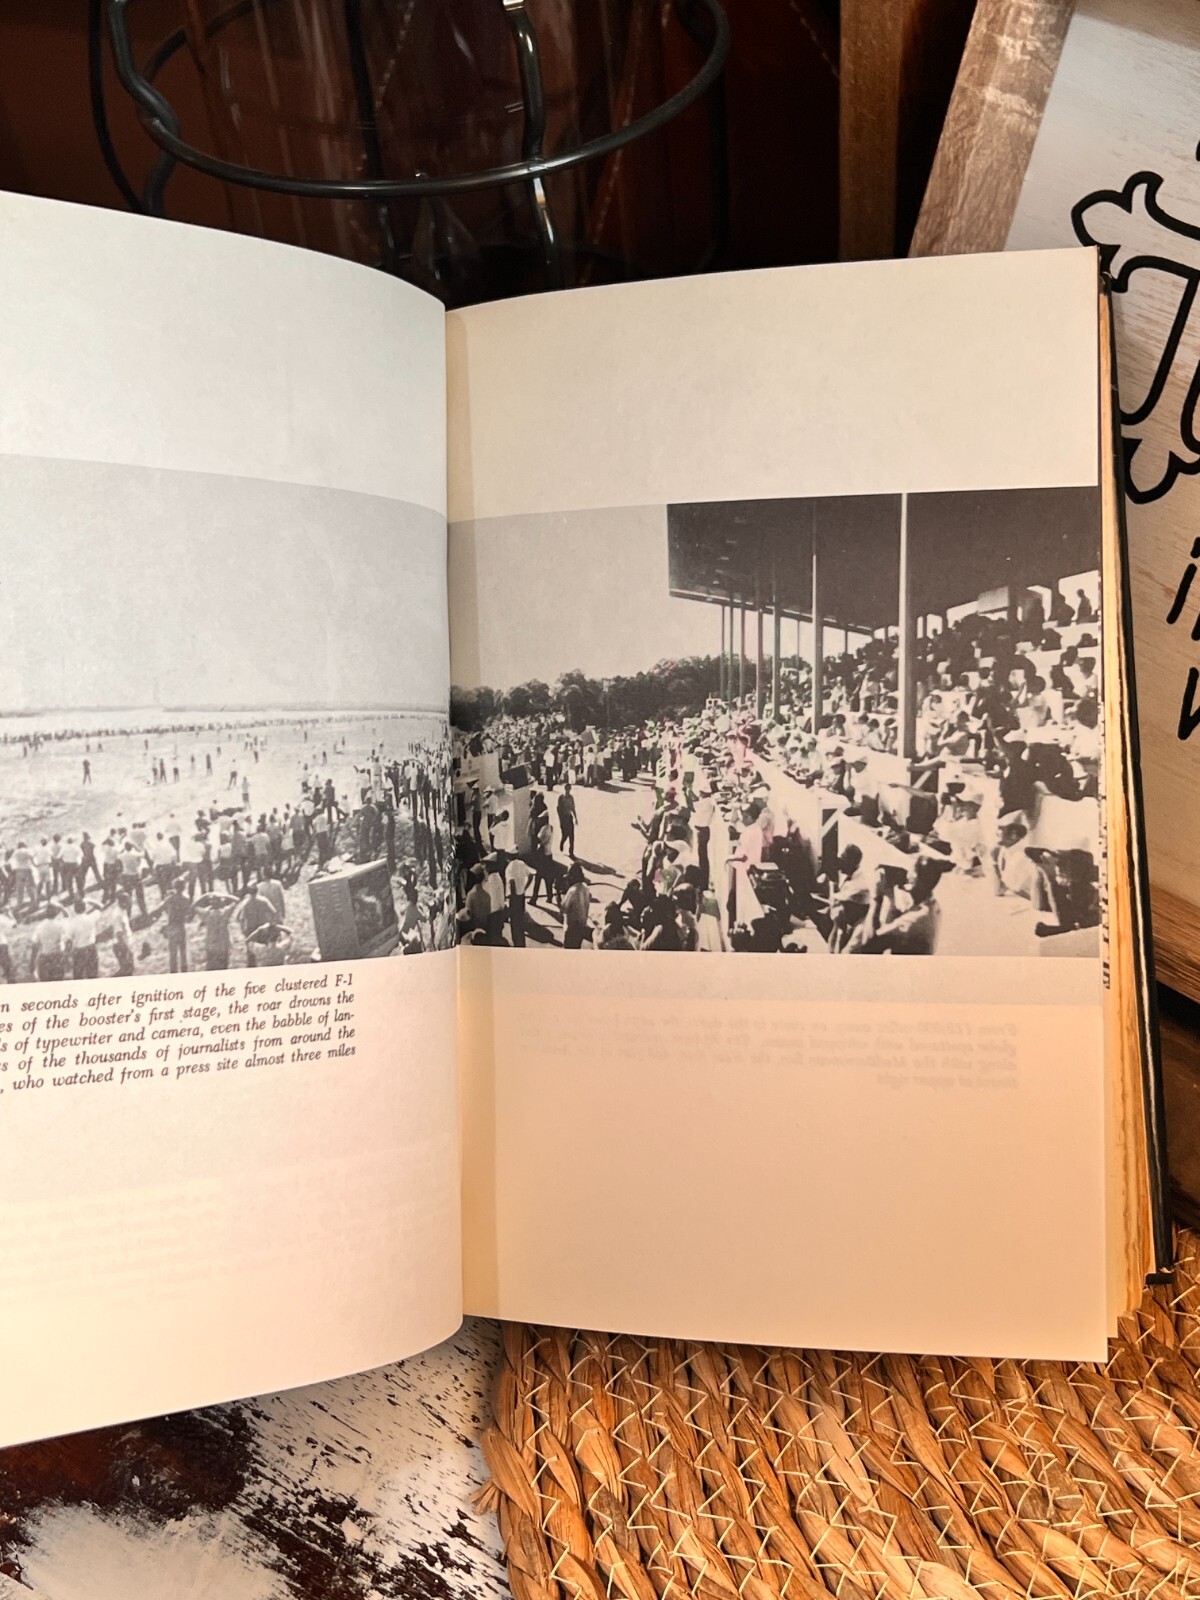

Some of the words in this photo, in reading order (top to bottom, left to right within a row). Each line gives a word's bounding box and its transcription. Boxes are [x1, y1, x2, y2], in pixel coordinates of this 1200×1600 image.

[21, 995, 79, 1012] seconds
[88, 993, 122, 1010] after
[131, 989, 184, 1007] ignition
[193, 986, 207, 1002] of
[215, 983, 236, 997] the
[244, 982, 266, 999] five
[274, 975, 328, 993] clustered
[335, 973, 353, 987] F-1
[22, 1017, 38, 1035] of
[46, 1015, 69, 1029] the
[79, 1009, 141, 1027] booster's
[148, 1008, 175, 1025] first
[182, 1005, 221, 1021] stage,
[229, 1002, 249, 1014] the
[257, 1000, 282, 1012] roar
[289, 995, 331, 1009] drowns
[337, 990, 355, 1004] the
[15, 1035, 30, 1054] of
[36, 1033, 113, 1053] typewriter
[119, 1027, 144, 1043] and
[151, 1026, 204, 1041] camera,
[210, 1023, 240, 1034] even
[246, 1018, 266, 1030] the
[272, 1013, 313, 1029] babble
[318, 1012, 330, 1028] of
[334, 1009, 355, 1023] lan-
[18, 1056, 34, 1074] of
[42, 1053, 66, 1069] the
[75, 1046, 148, 1066] thousands
[156, 1045, 170, 1062] of
[178, 1038, 245, 1060] journalists
[253, 1035, 283, 1052] from
[290, 1028, 331, 1045] around
[338, 1026, 356, 1038] the
[13, 1075, 44, 1090] who
[53, 1068, 114, 1086] watched
[121, 1067, 154, 1084] from
[161, 1066, 169, 1076] a
[176, 1061, 210, 1079] press
[217, 1058, 239, 1071] site
[245, 1054, 285, 1068] almost
[291, 1048, 322, 1063] three
[327, 1043, 356, 1058] miles
